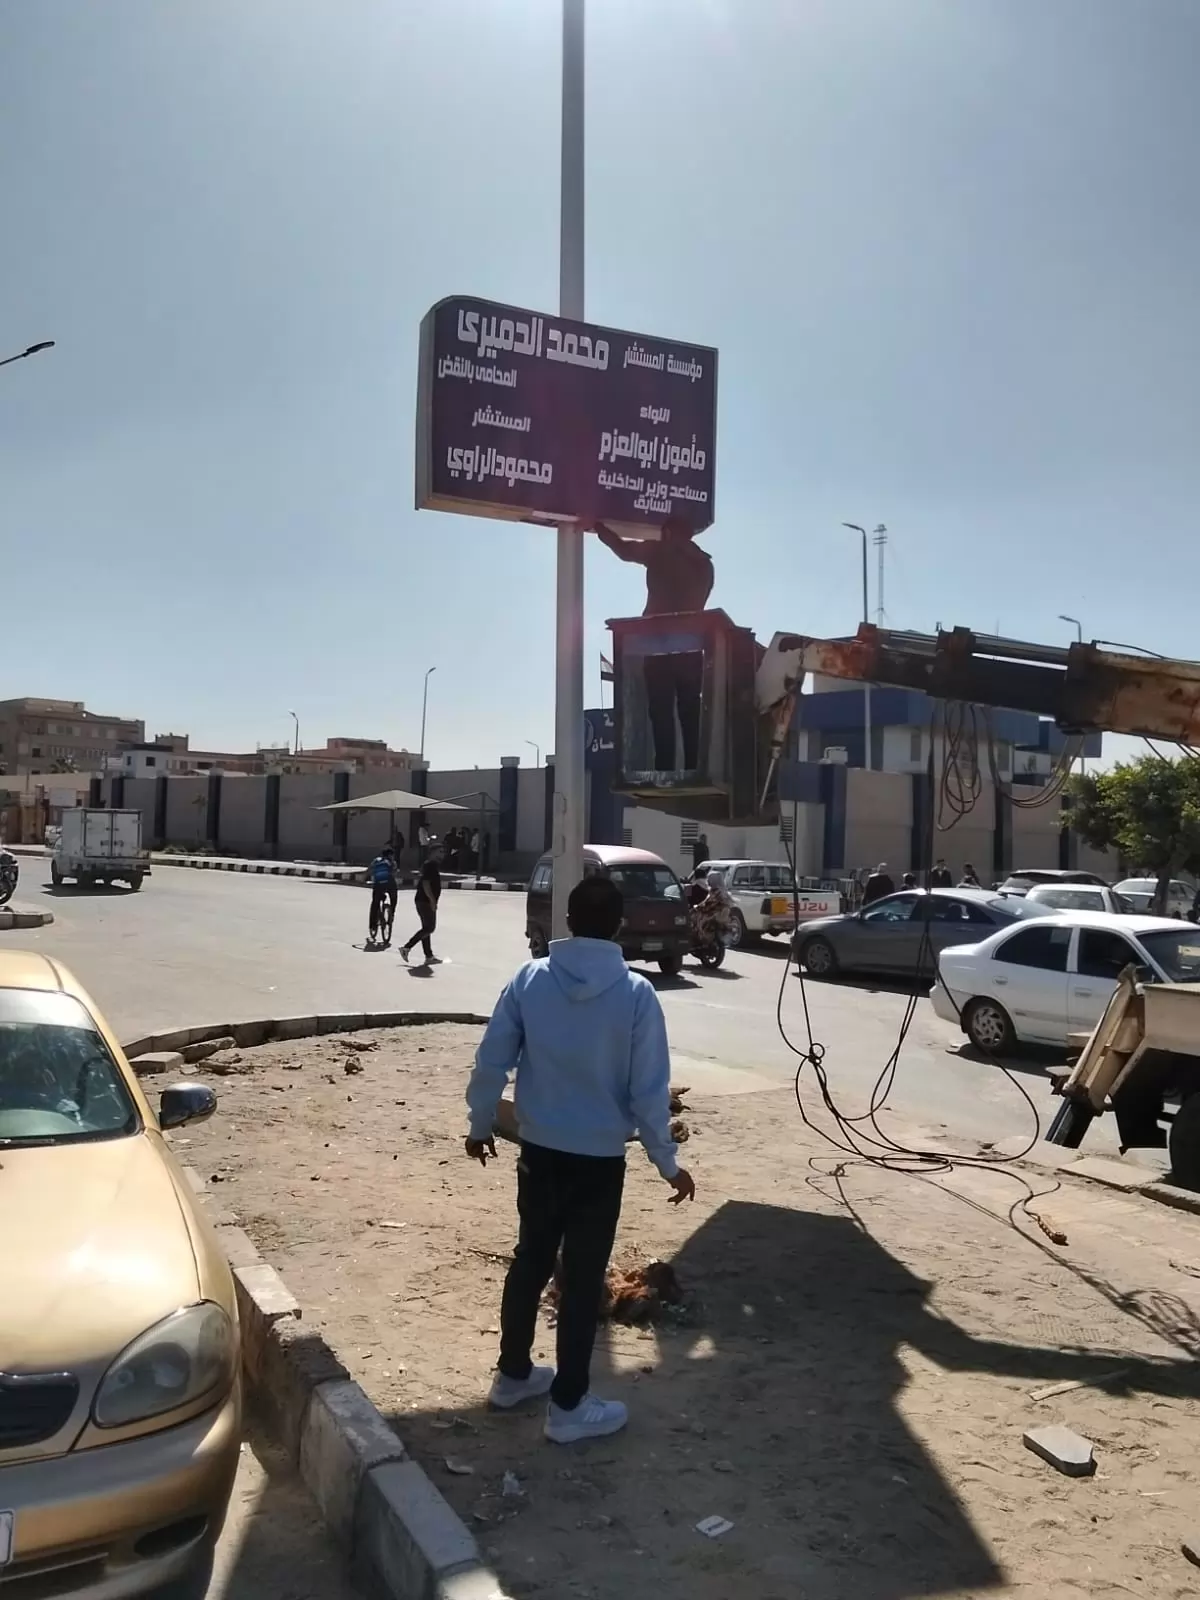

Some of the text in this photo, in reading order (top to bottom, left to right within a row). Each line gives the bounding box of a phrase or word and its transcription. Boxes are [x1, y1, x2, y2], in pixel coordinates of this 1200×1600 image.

[547, 328, 609, 371] محمد
[623, 341, 665, 371] المستشار
[438, 354, 475, 384] بالنقض
[667, 354, 703, 383] مؤسسة
[472, 405, 531, 432] المستشار
[640, 405, 671, 424] اللواء
[659, 434, 706, 474] مأمون
[598, 470, 708, 502] مساعد وزير الداخلية
[633, 494, 672, 515] السابق
[786, 902, 828, 912] SUZU
